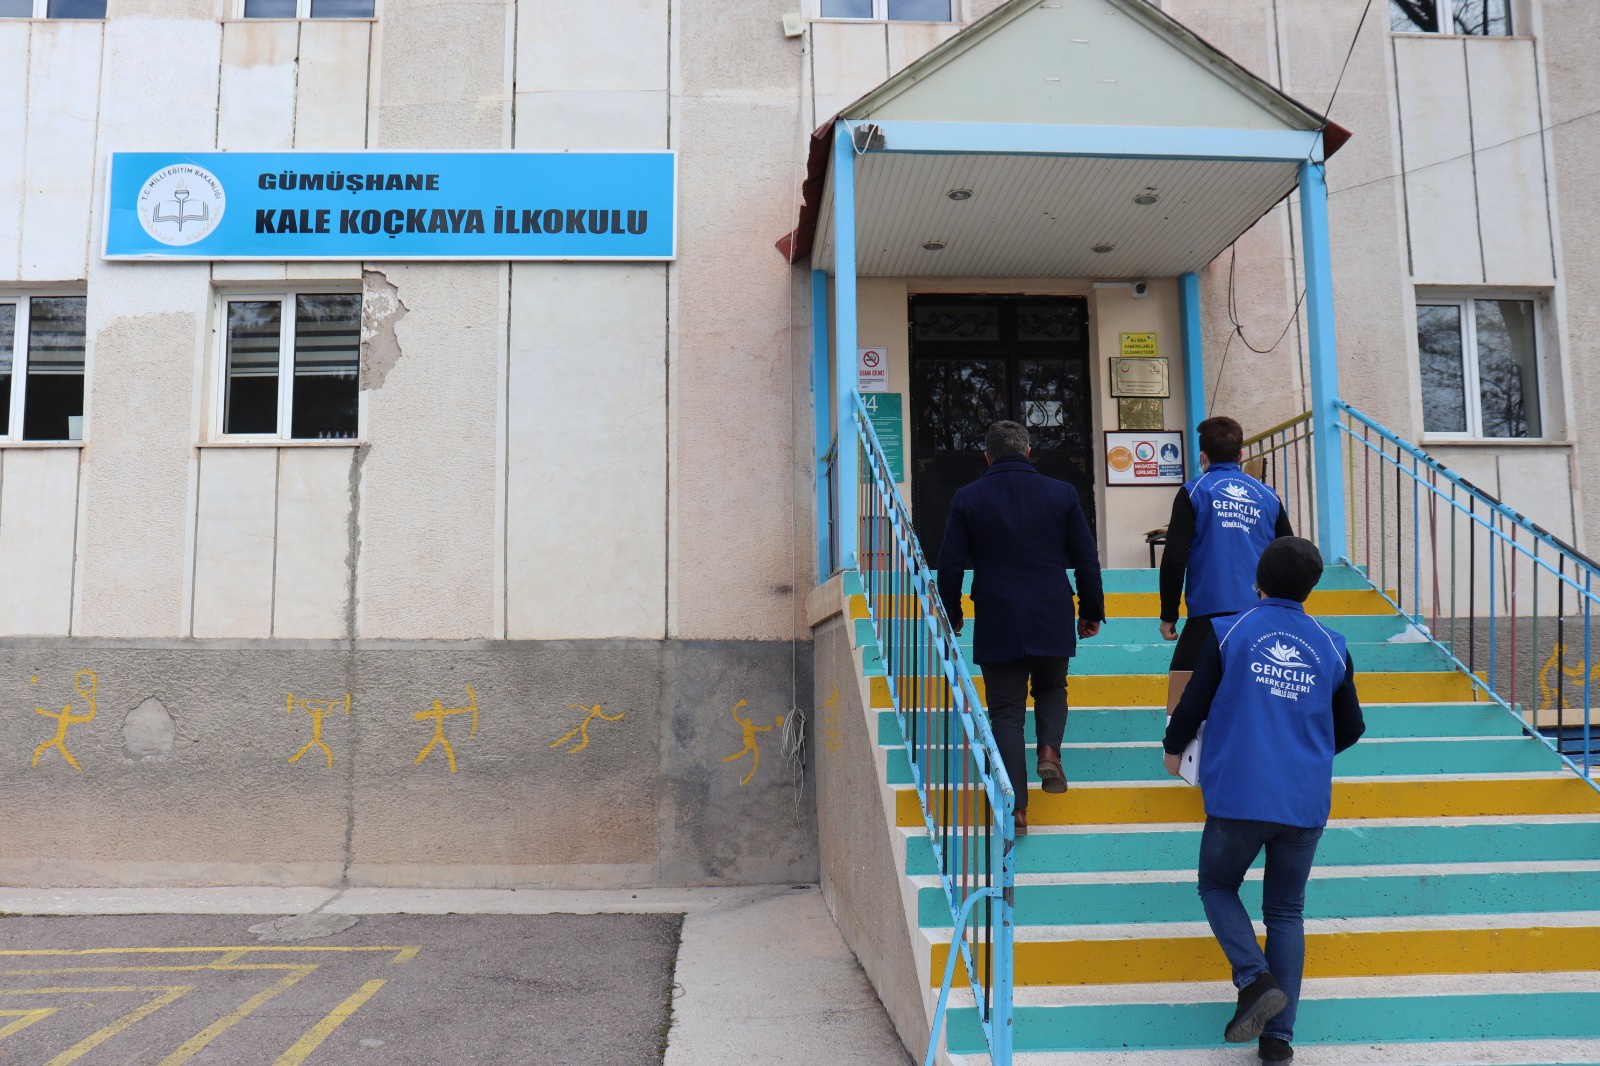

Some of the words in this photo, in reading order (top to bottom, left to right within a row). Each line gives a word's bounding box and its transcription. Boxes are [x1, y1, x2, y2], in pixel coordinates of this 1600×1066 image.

[149, 172, 167, 188] MİLLİ
[167, 167, 193, 176] EĞİTİM
[194, 170, 221, 199] BAKANLIĞI
[258, 171, 439, 194] GÜMÜŞHANE
[255, 209, 331, 234] KALE
[339, 209, 485, 239] KOÇKAYA
[494, 206, 648, 235] İLKOKULU
[1250, 662, 1316, 686] GENÇLİK
[1255, 675, 1310, 694] MERKEZLERİ
